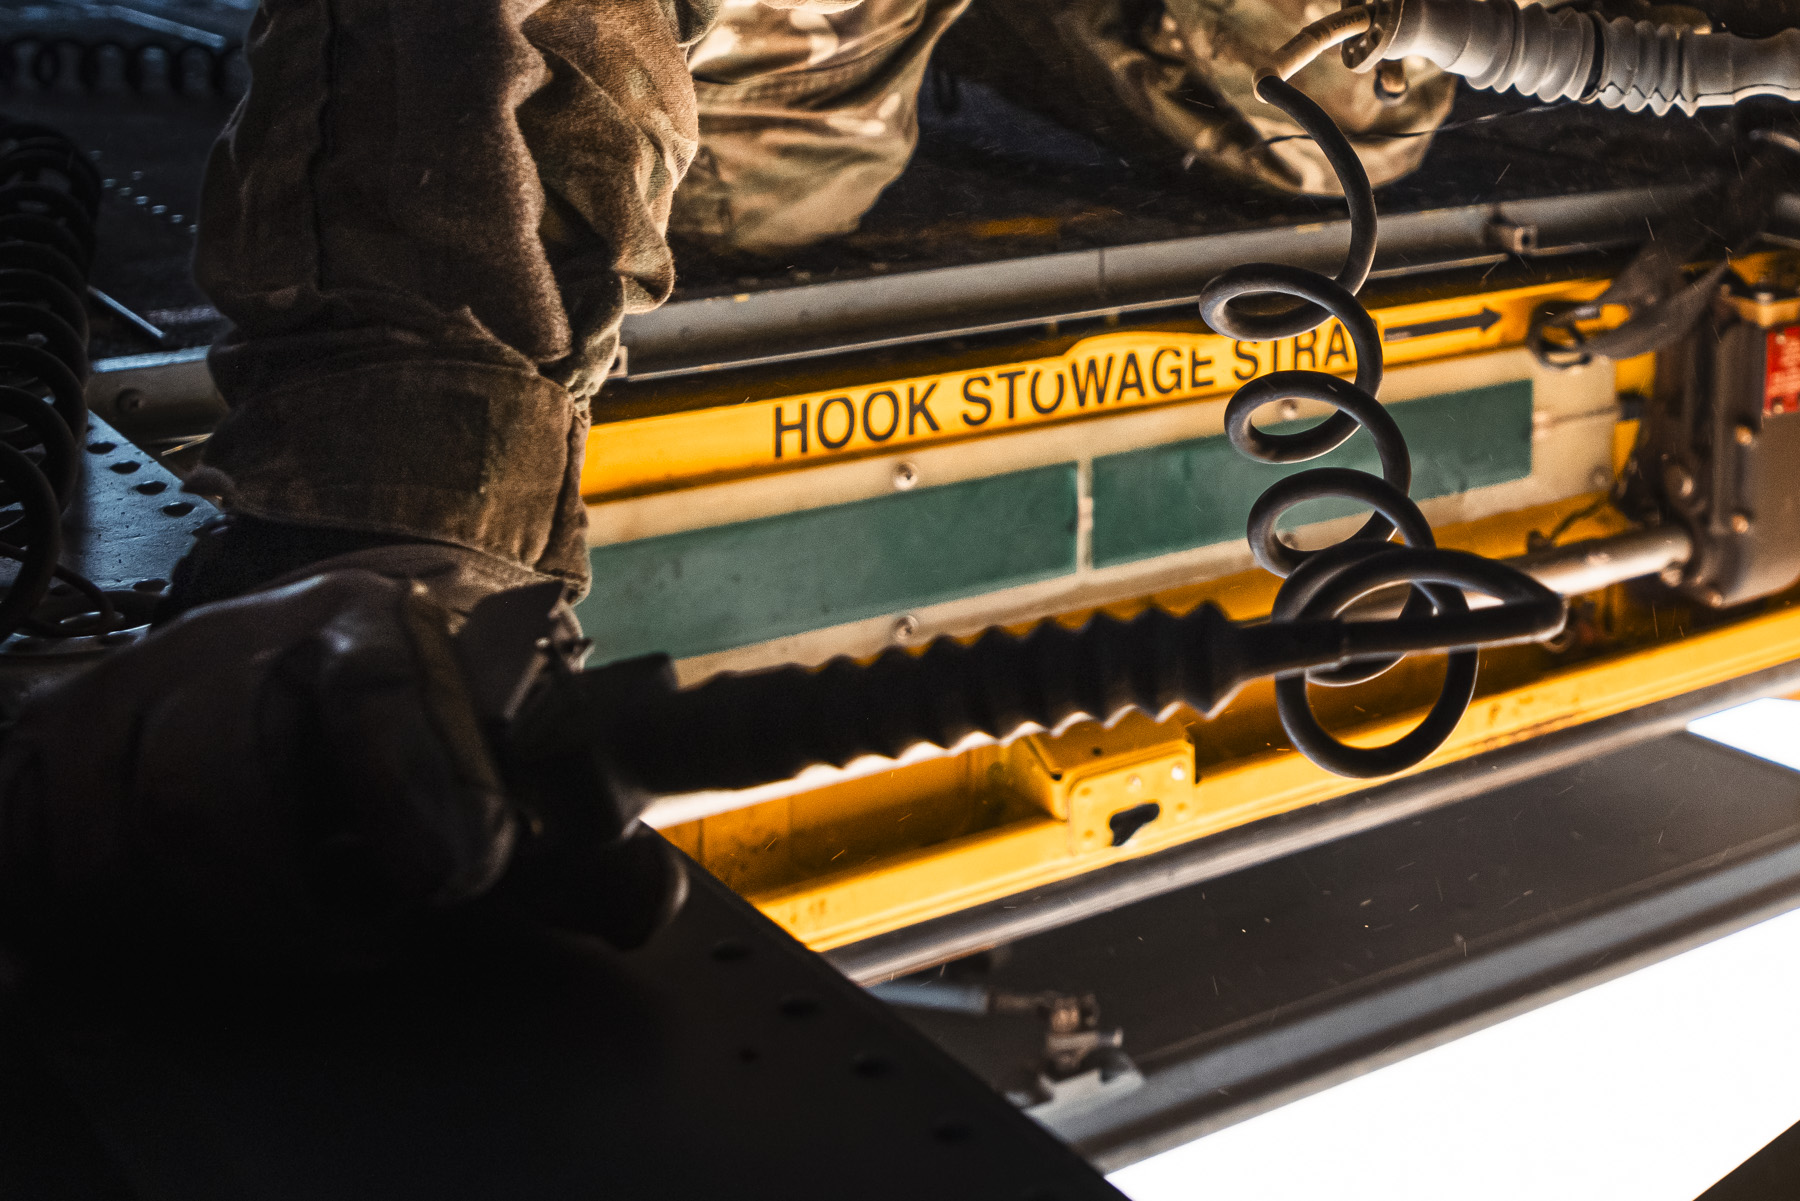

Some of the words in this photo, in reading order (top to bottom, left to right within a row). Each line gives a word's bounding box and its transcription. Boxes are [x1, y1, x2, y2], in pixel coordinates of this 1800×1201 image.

[773, 379, 941, 458] HOOK
[961, 345, 1215, 427] STOWAGE
[1233, 319, 1377, 382] STRA
